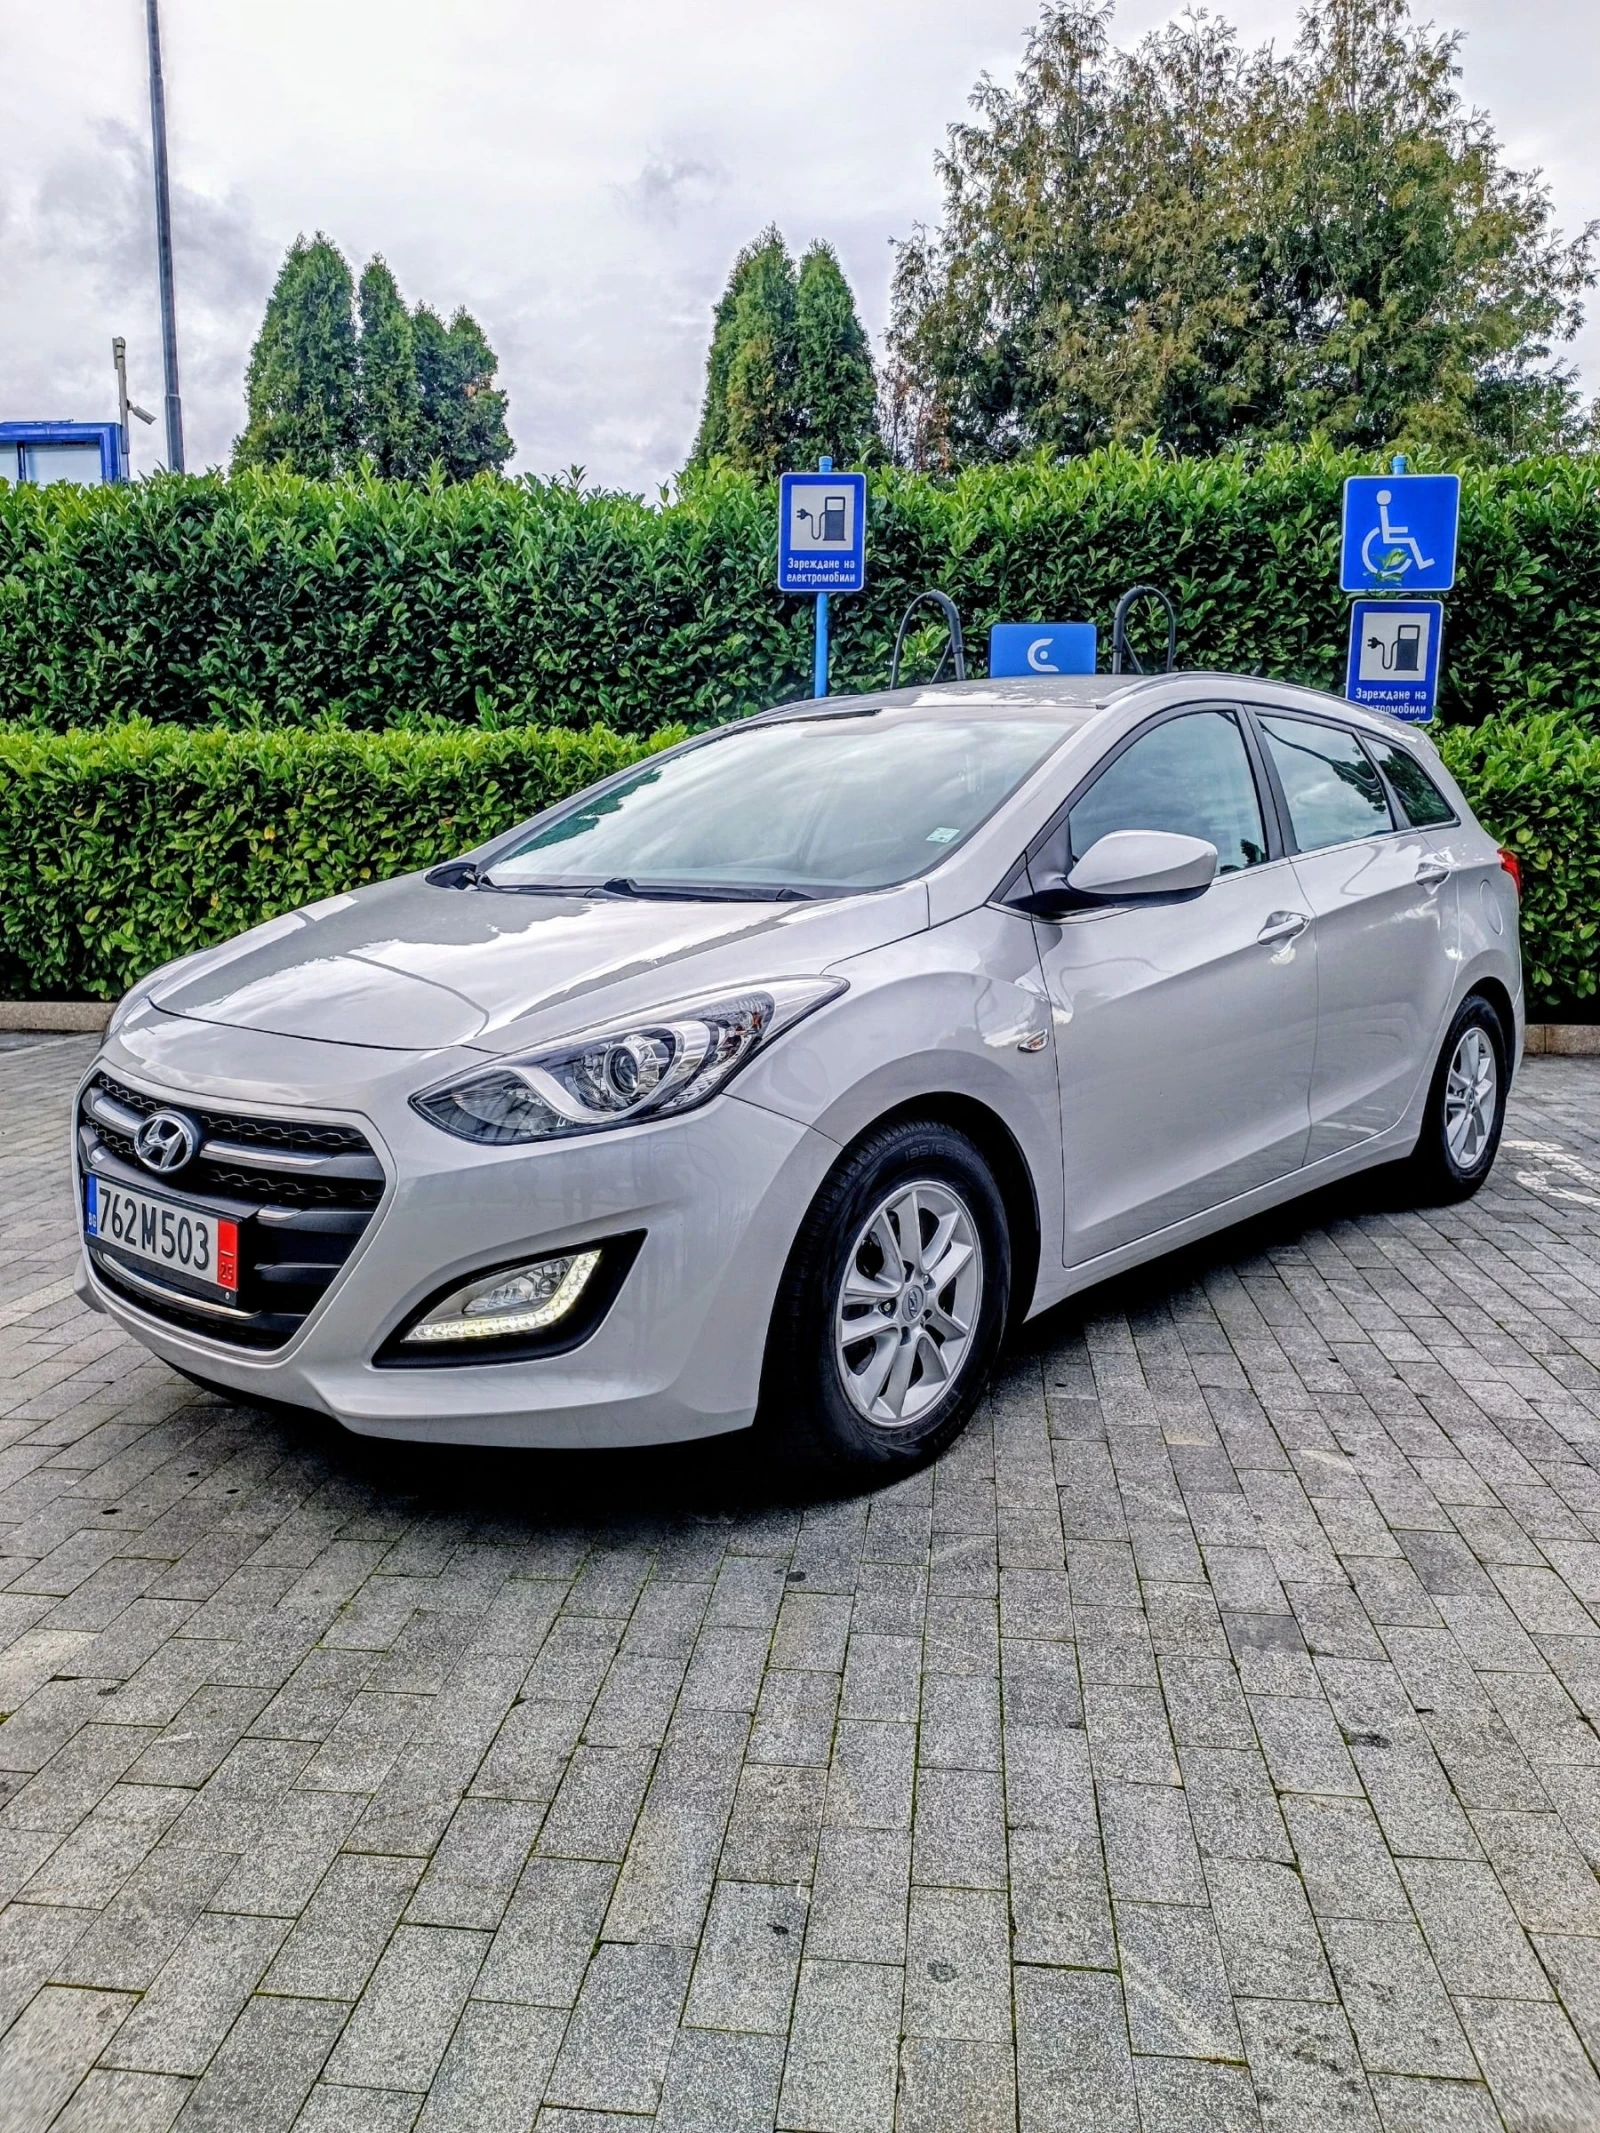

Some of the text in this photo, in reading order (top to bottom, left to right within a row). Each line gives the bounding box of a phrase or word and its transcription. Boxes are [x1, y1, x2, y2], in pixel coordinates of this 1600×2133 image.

[787, 557, 856, 571] Зареждане на
[786, 571, 856, 586] електромобили
[1355, 687, 1427, 702] Зареждане на
[88, 1212, 97, 1228] BG
[220, 1261, 234, 1281] 25
